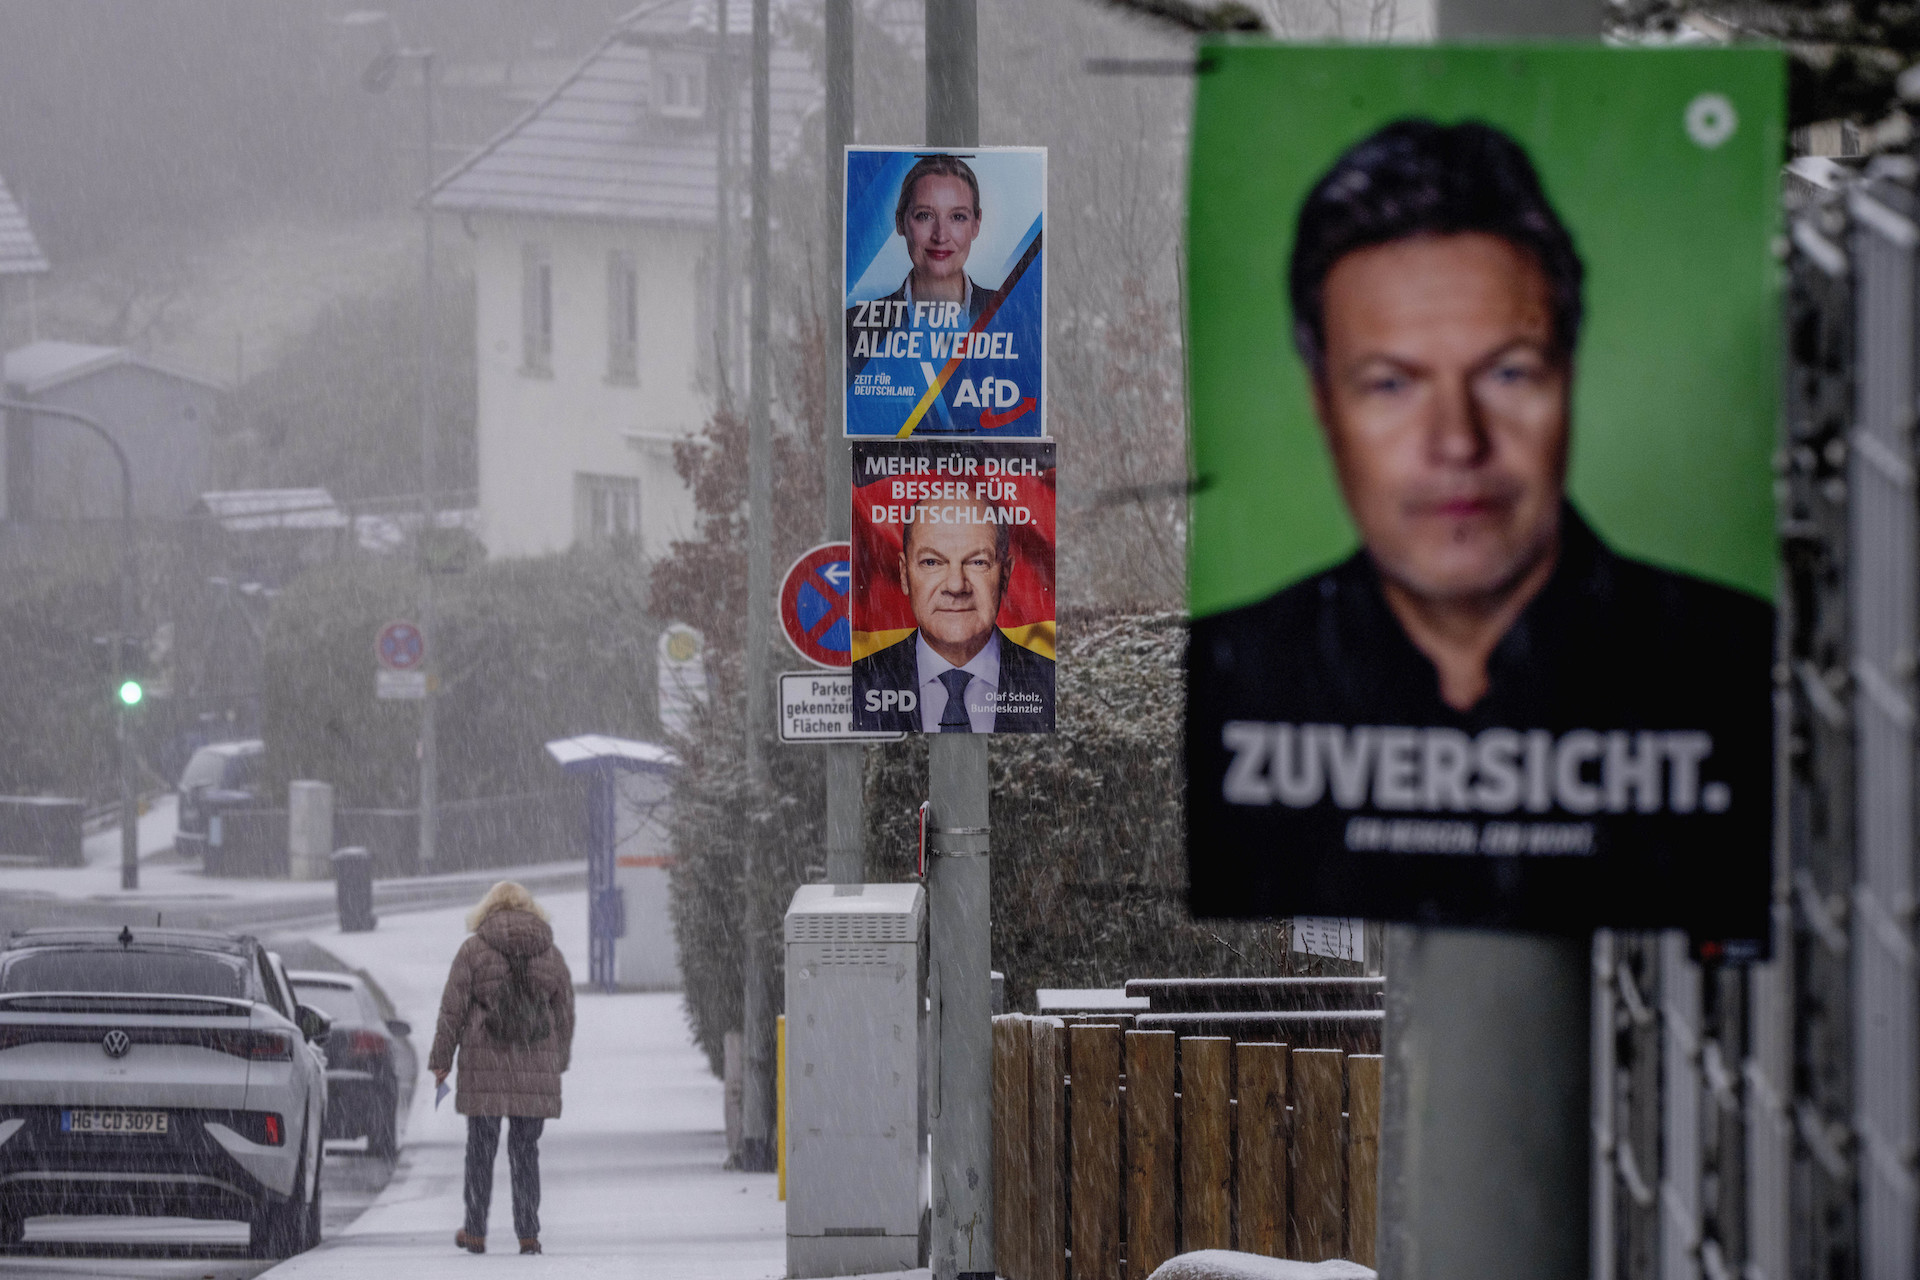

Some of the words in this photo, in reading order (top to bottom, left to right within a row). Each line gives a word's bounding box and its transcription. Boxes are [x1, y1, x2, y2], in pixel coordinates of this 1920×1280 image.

[853, 301, 908, 327] ZEIT
[913, 301, 961, 328] FÜR
[853, 331, 924, 358] ALICE
[930, 332, 1019, 359] WEIDEL
[854, 374, 873, 385] ZEIT
[874, 373, 891, 385] FÜR
[854, 386, 916, 396] DEUTSCHLAND.
[952, 376, 1020, 408] AfD
[865, 456, 930, 475] MEHR
[936, 453, 978, 476] FÜR
[984, 458, 1044, 477] DICH.
[891, 481, 969, 500] BESSER
[975, 477, 1017, 500] FÜR
[871, 505, 1038, 525] DEUTSCHLAND.
[865, 689, 917, 712] SPD
[971, 703, 1043, 714] Bundeskanzler
[985, 692, 1007, 702] Olaf
[1008, 692, 1043, 703] Scholz,
[793, 718, 842, 733] Flächen
[1222, 720, 1732, 813] ZUVERSICHT.
